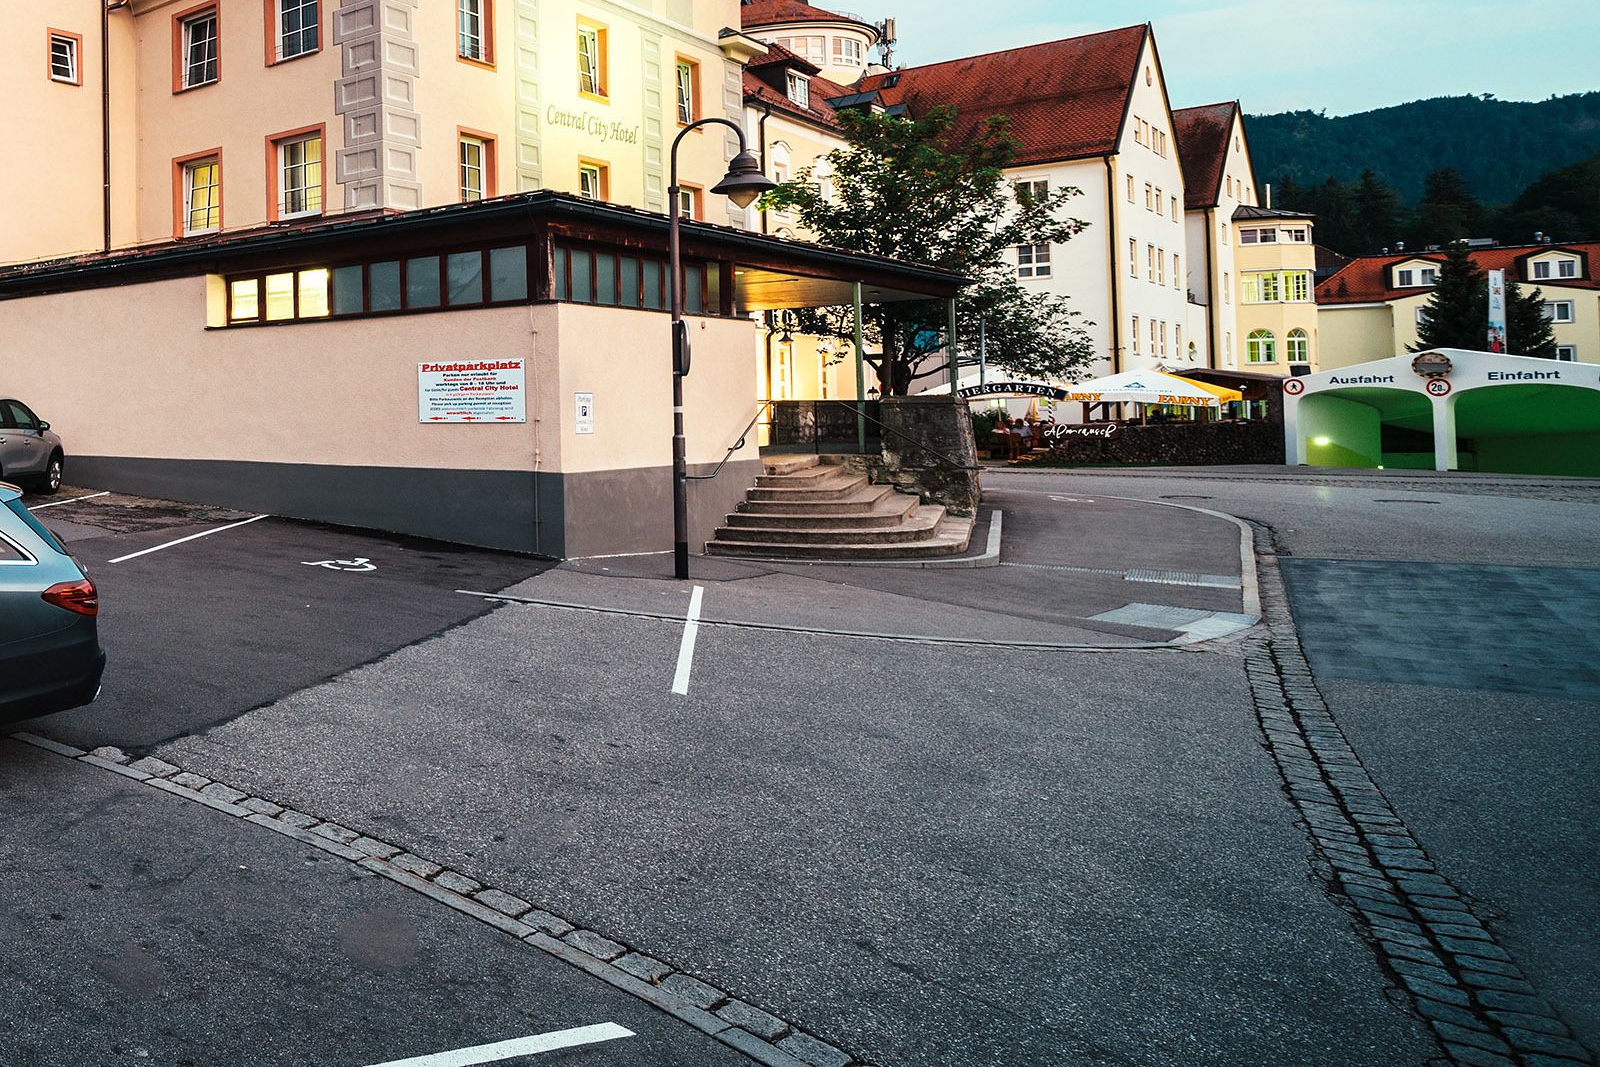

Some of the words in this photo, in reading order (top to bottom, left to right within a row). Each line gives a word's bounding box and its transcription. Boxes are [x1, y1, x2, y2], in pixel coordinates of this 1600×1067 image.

[547, 104, 587, 130] Central
[588, 116, 608, 142] City
[610, 122, 639, 144] Hotel
[422, 360, 521, 372] Privatparkplatz
[1329, 375, 1394, 384] Ausfahrt
[1487, 370, 1561, 380] Einfahrt
[958, 384, 1057, 398] BIERGARTEN
[1064, 392, 1104, 401] ARNY
[1158, 394, 1213, 406] FARNY
[1044, 424, 1116, 438] Almrausch
